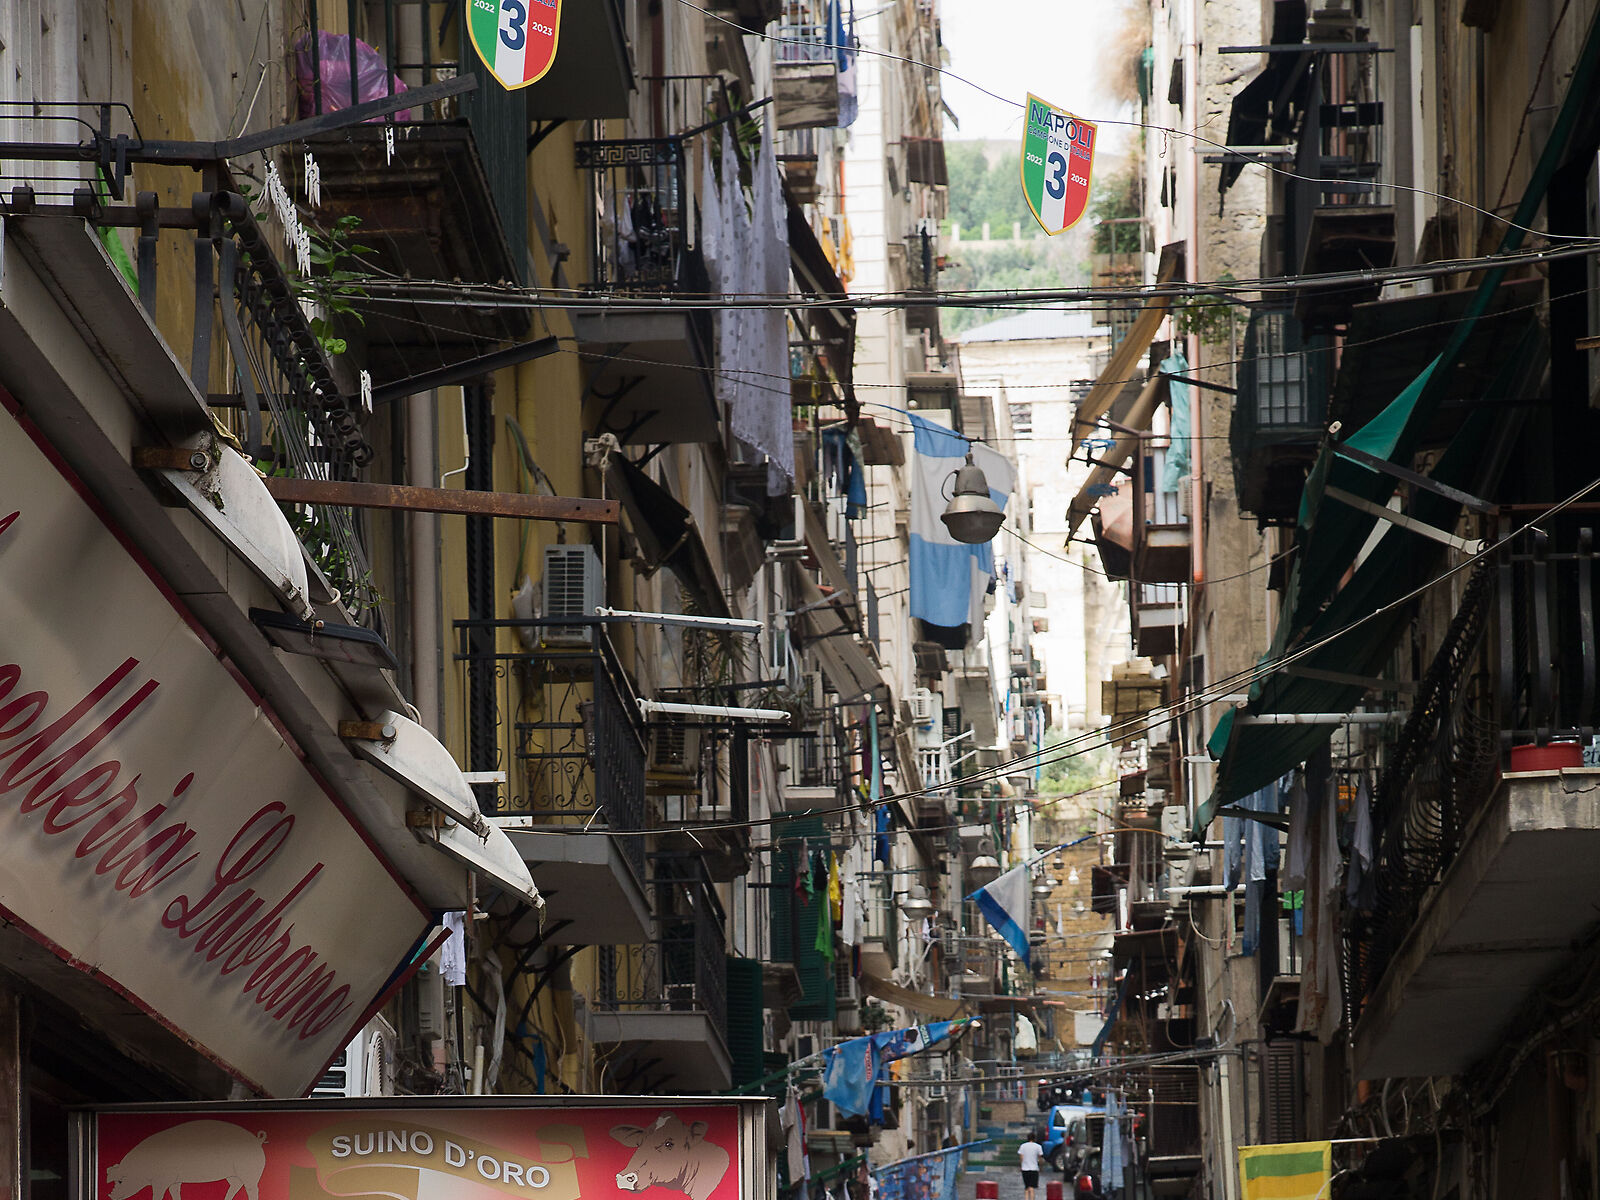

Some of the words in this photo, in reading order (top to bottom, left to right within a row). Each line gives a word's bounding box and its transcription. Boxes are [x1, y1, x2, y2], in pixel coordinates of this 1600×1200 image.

[473, 0, 495, 14] 2022
[499, 0, 526, 51] 3
[532, 21, 553, 37] 2023
[1027, 125, 1063, 149] CAMPIONE
[1030, 103, 1092, 149] NAPOLI
[1026, 152, 1043, 166] 2022
[1045, 151, 1067, 200] 3
[1070, 173, 1088, 187] 2023
[161, 800, 354, 1040] Lubrano
[331, 1130, 434, 1158] SUINO
